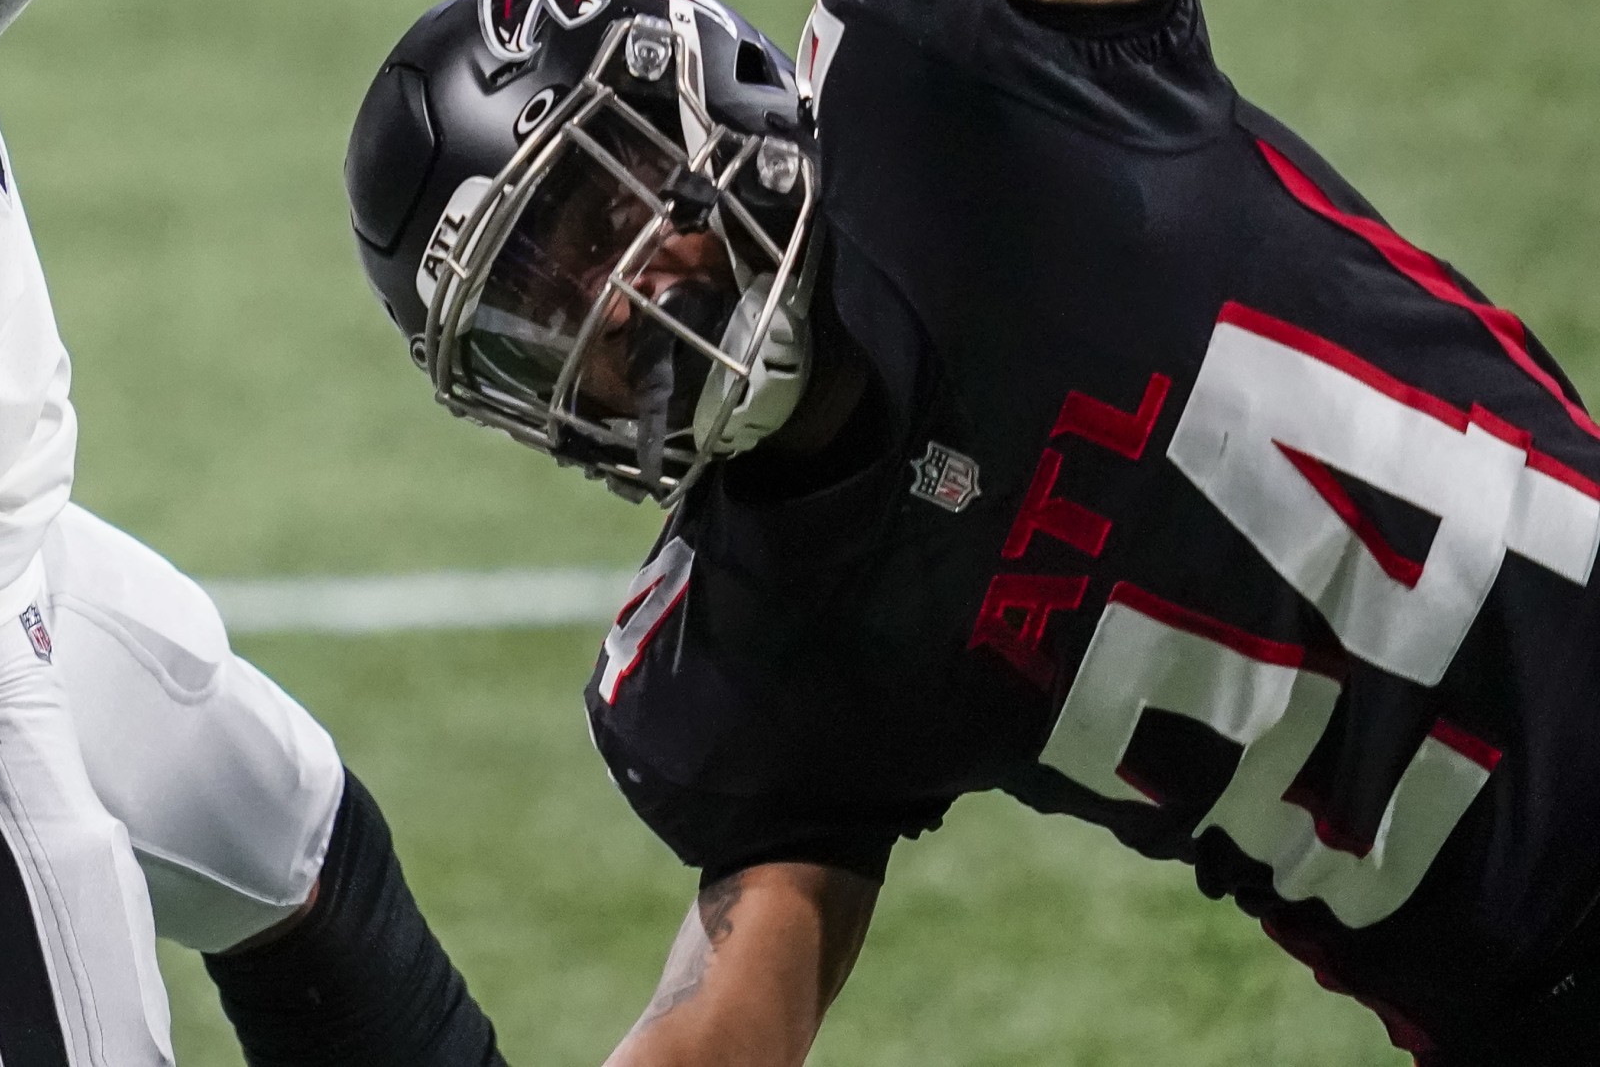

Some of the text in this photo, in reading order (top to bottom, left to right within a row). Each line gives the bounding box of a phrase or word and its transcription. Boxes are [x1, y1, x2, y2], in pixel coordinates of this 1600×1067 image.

[423, 213, 467, 282] ATL
[966, 371, 1172, 687] ATL
[1038, 301, 1600, 930] 24
